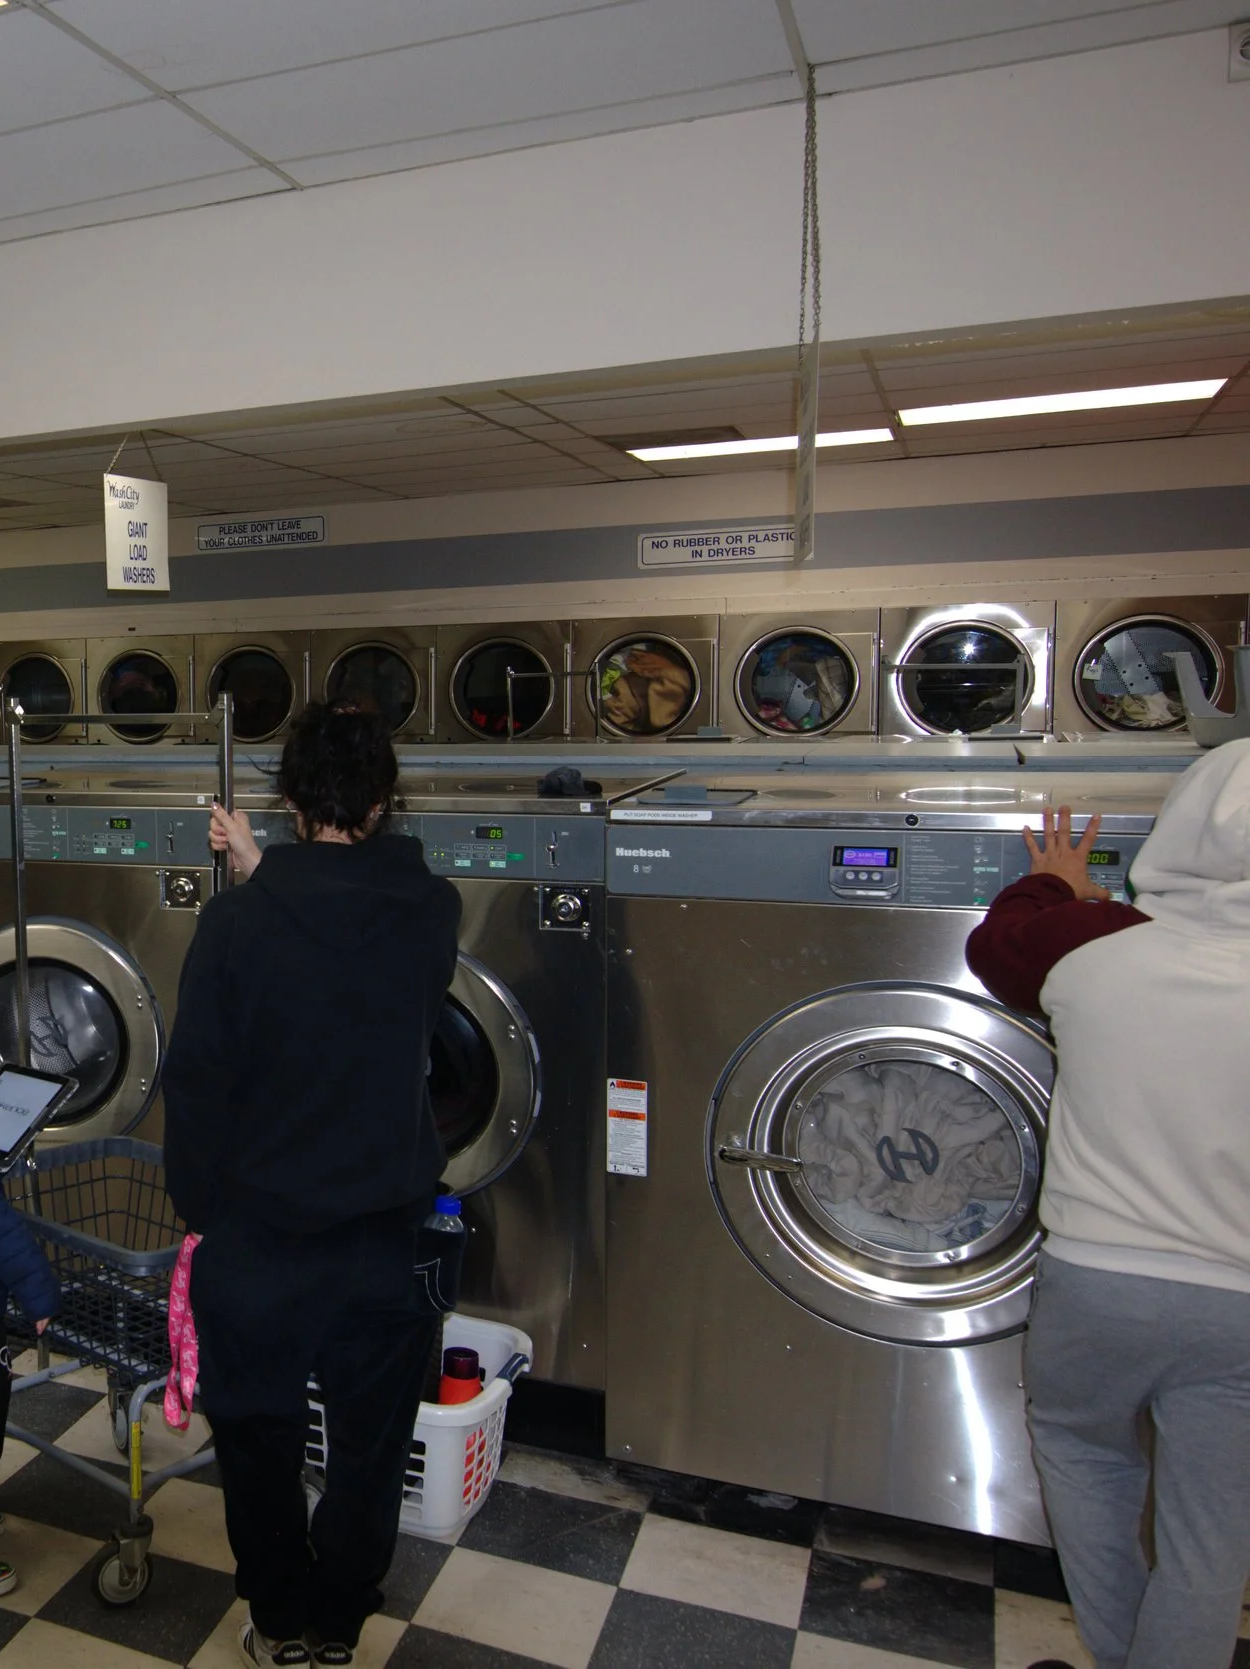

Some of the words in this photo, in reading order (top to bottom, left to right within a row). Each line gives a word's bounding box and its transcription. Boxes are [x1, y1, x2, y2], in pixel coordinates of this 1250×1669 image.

[128, 520, 148, 538] GIANT
[219, 525, 248, 535] PLEASE
[251, 522, 274, 532] DON'T
[278, 520, 301, 530] LEAVE
[205, 538, 225, 547] YOUR
[228, 535, 263, 546] CLOTHES
[266, 531, 318, 543] UNATTENDED
[652, 540, 668, 549] NO
[674, 536, 720, 548] RUBBER
[726, 535, 743, 545] OR
[129, 544, 148, 561] LOAD
[692, 550, 703, 558] IN
[708, 546, 756, 558] DRYERS
[122, 566, 156, 584] WASHERS
[616, 847, 670, 858] Huebsch
[633, 864, 639, 873] 8
